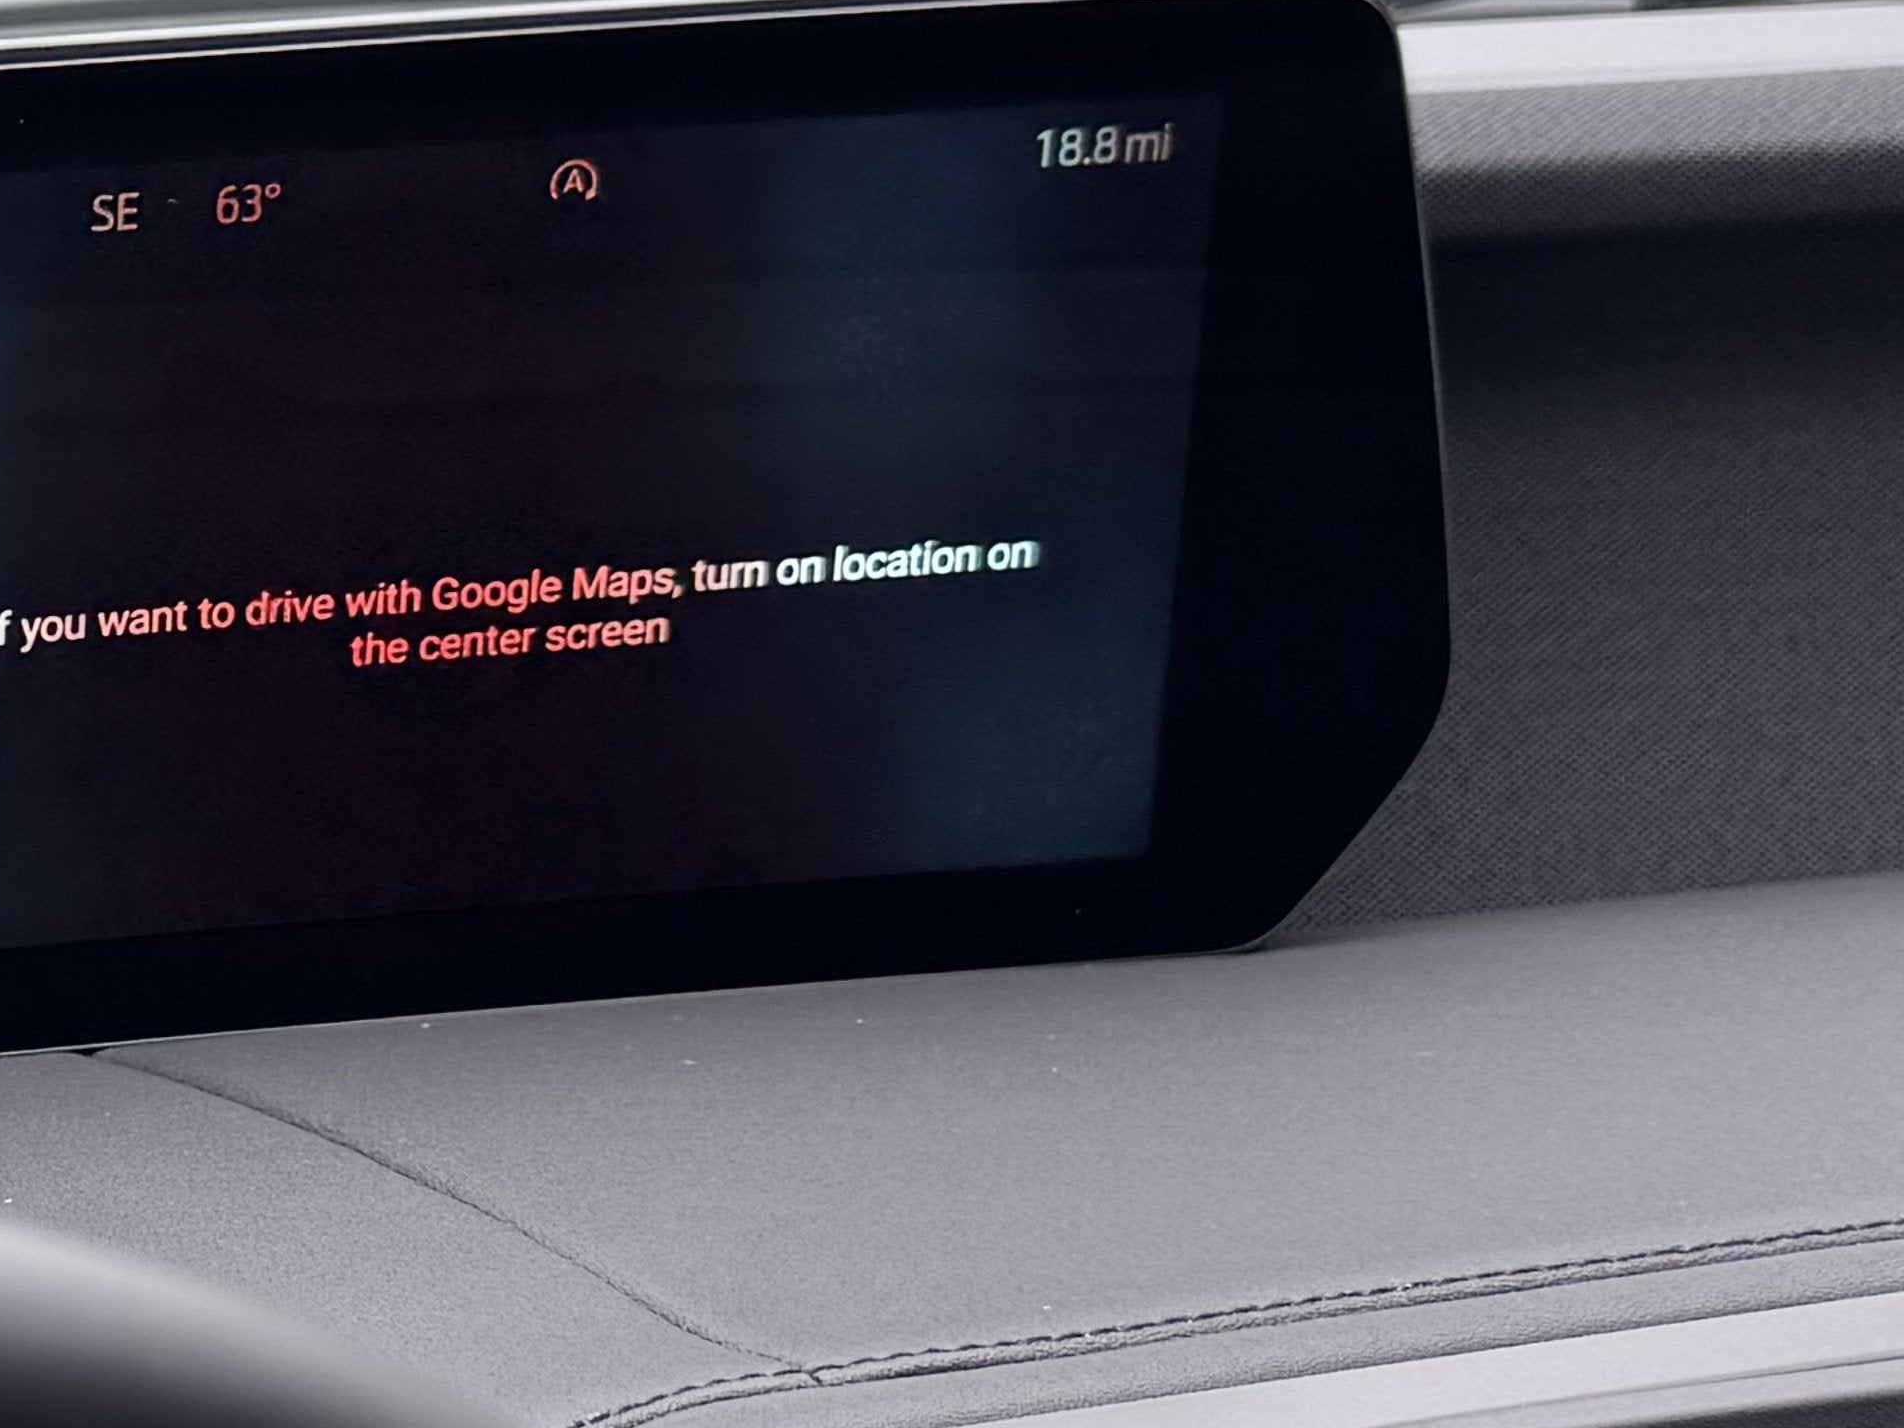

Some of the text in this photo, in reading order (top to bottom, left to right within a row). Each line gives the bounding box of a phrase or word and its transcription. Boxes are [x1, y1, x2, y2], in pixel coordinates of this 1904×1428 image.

[91, 192, 140, 233] SE
[20, 612, 86, 653] you
[98, 600, 187, 638] want
[197, 597, 235, 629] to
[246, 590, 335, 626] drive
[345, 578, 422, 618] with
[432, 569, 562, 614] Google
[572, 565, 684, 604] Maps,
[692, 558, 769, 592] turn
[776, 555, 826, 586] on
[833, 540, 981, 583] location
[987, 540, 1041, 571] on
[350, 615, 671, 668] the center screen
